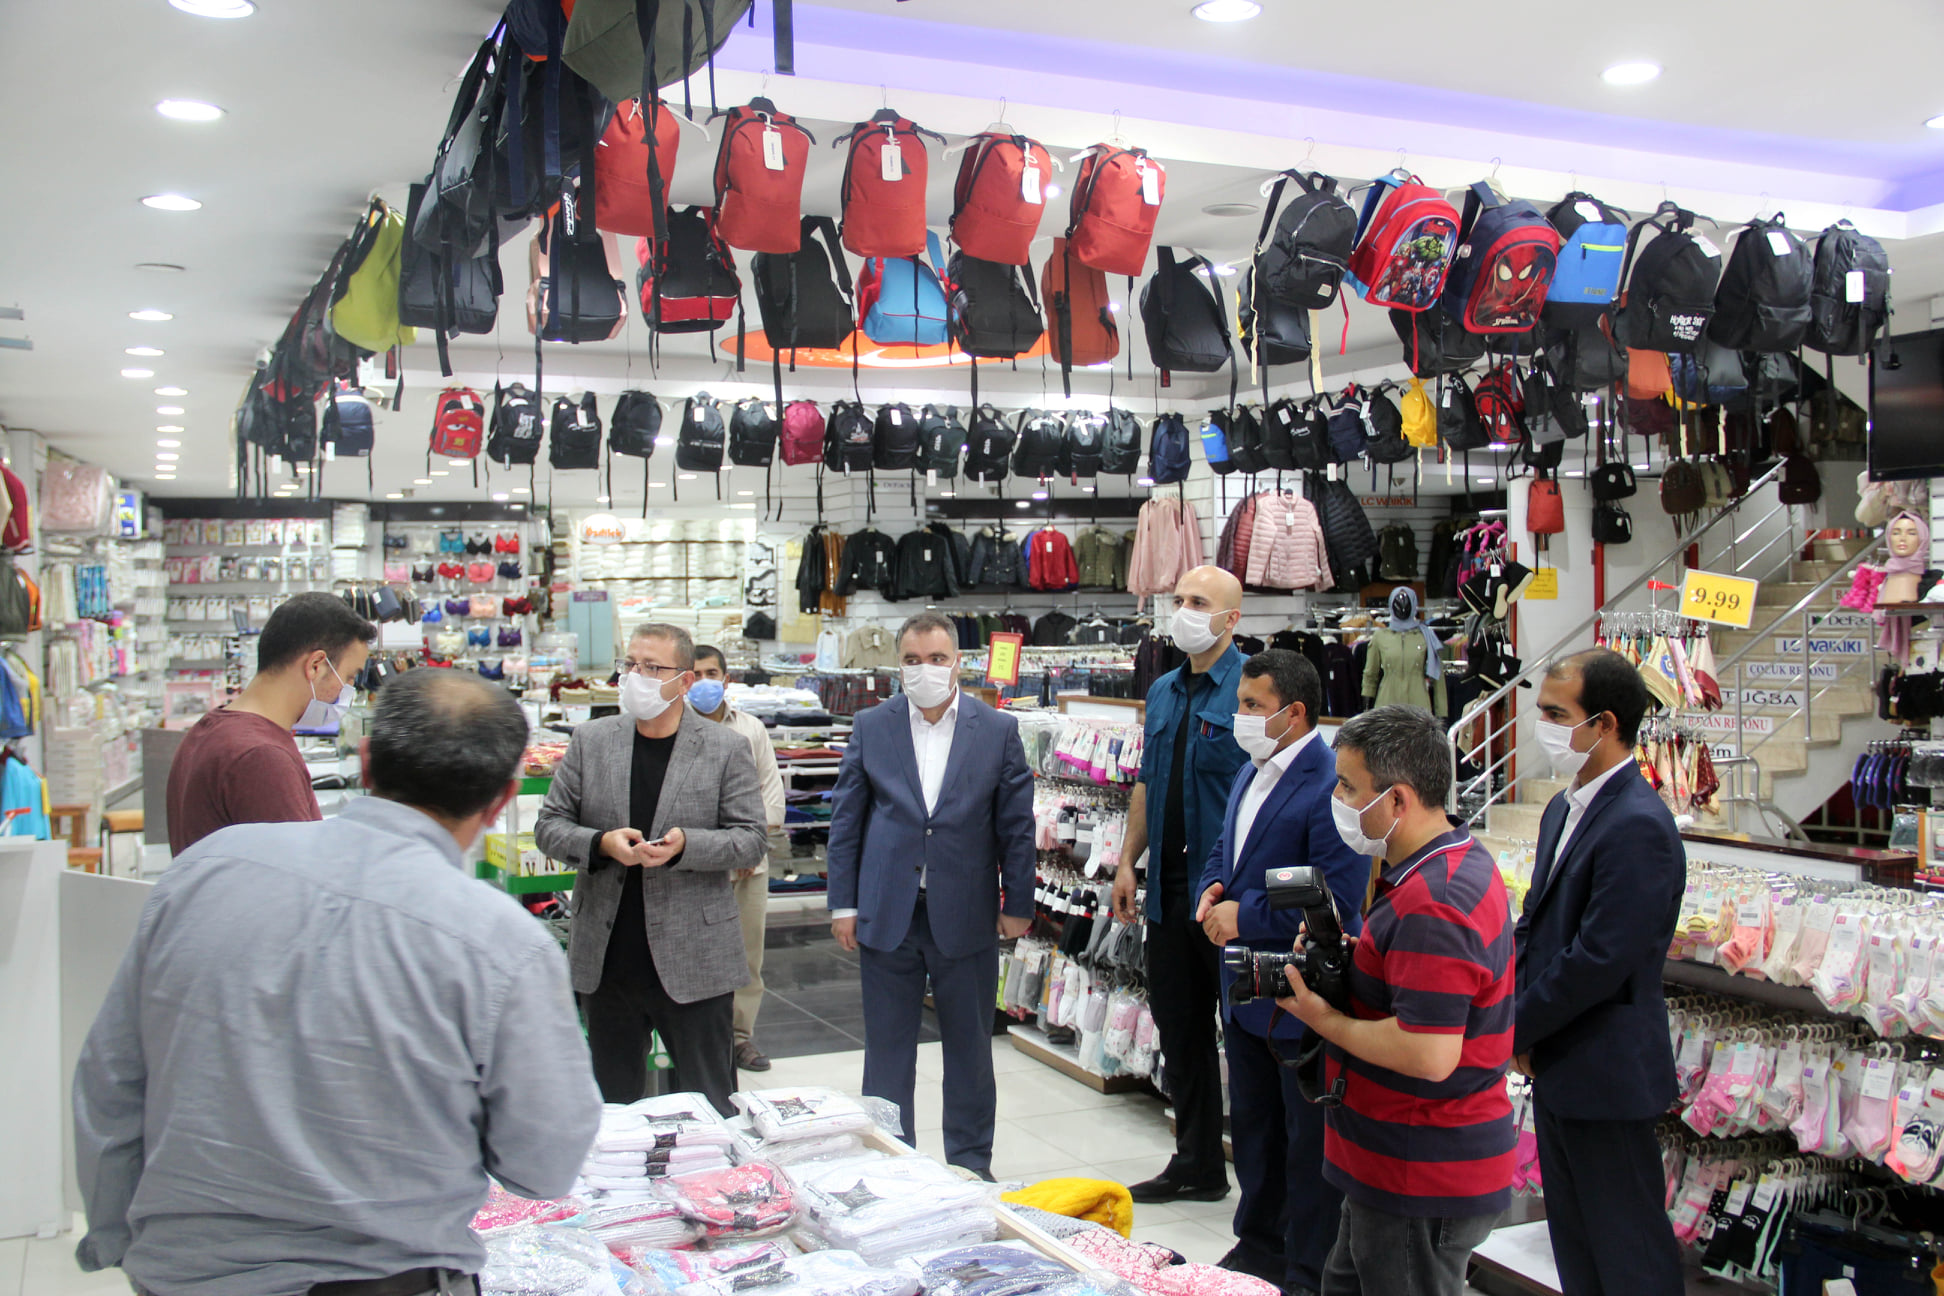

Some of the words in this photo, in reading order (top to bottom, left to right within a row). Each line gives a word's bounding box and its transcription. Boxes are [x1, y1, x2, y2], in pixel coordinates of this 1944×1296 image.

[1694, 586, 1741, 611] 9.99
[1788, 665, 1834, 677] REONU
[1723, 717, 1769, 731] REONU
